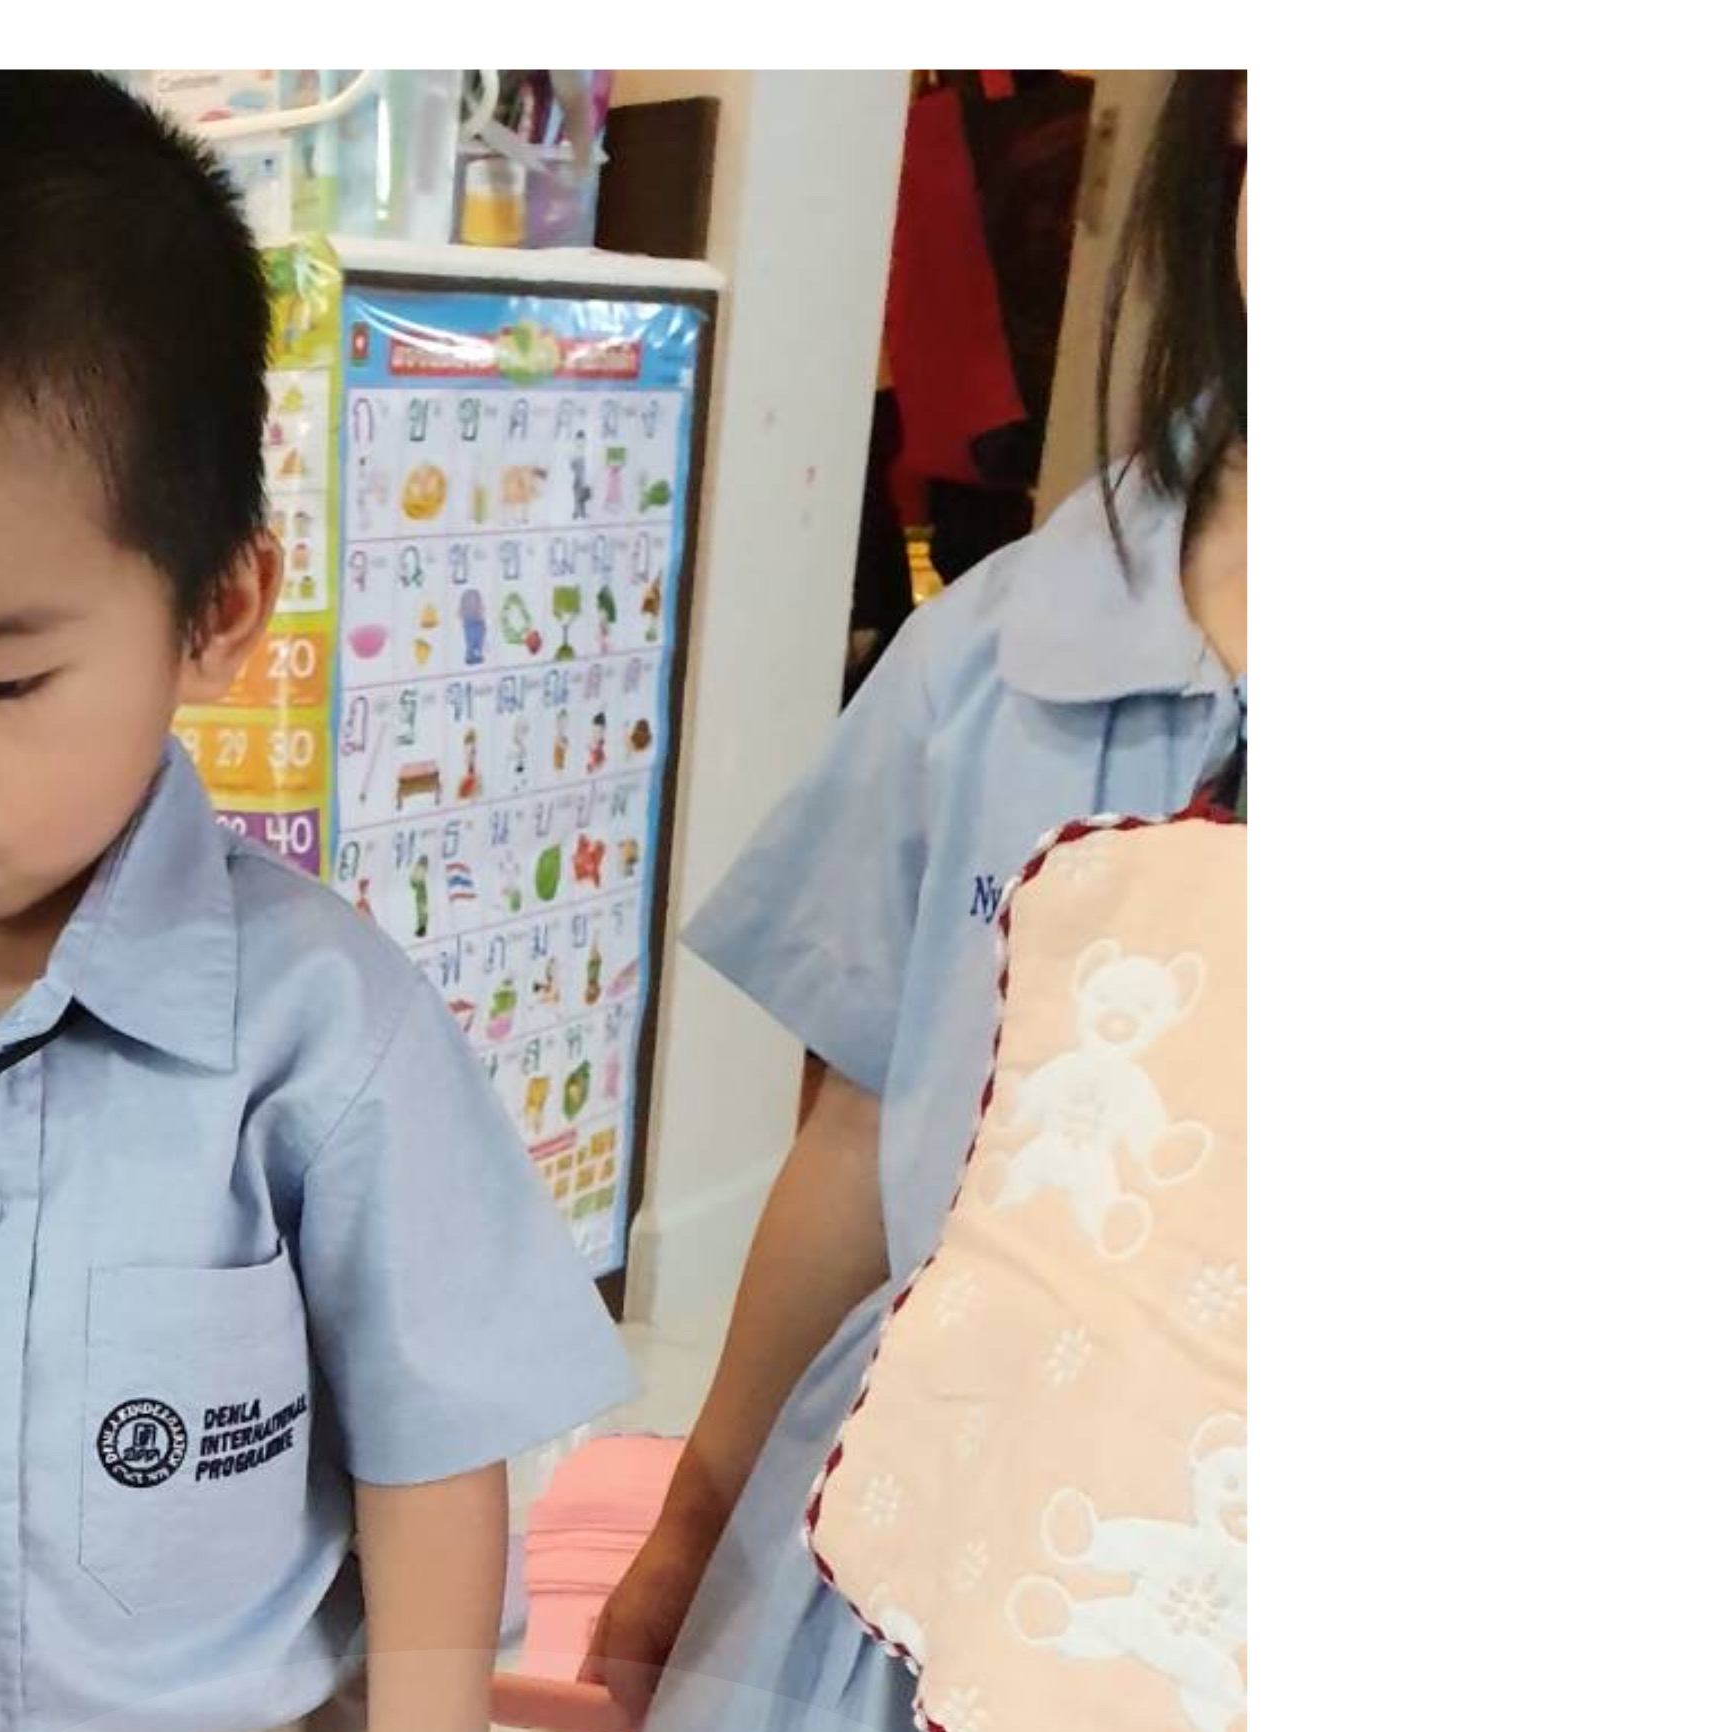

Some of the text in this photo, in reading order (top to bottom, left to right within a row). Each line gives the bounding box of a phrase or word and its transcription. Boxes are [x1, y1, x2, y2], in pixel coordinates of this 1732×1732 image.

[266, 637, 318, 680] 20
[267, 730, 315, 769] 30
[265, 814, 312, 855] 40
[203, 1398, 261, 1431] DENLA
